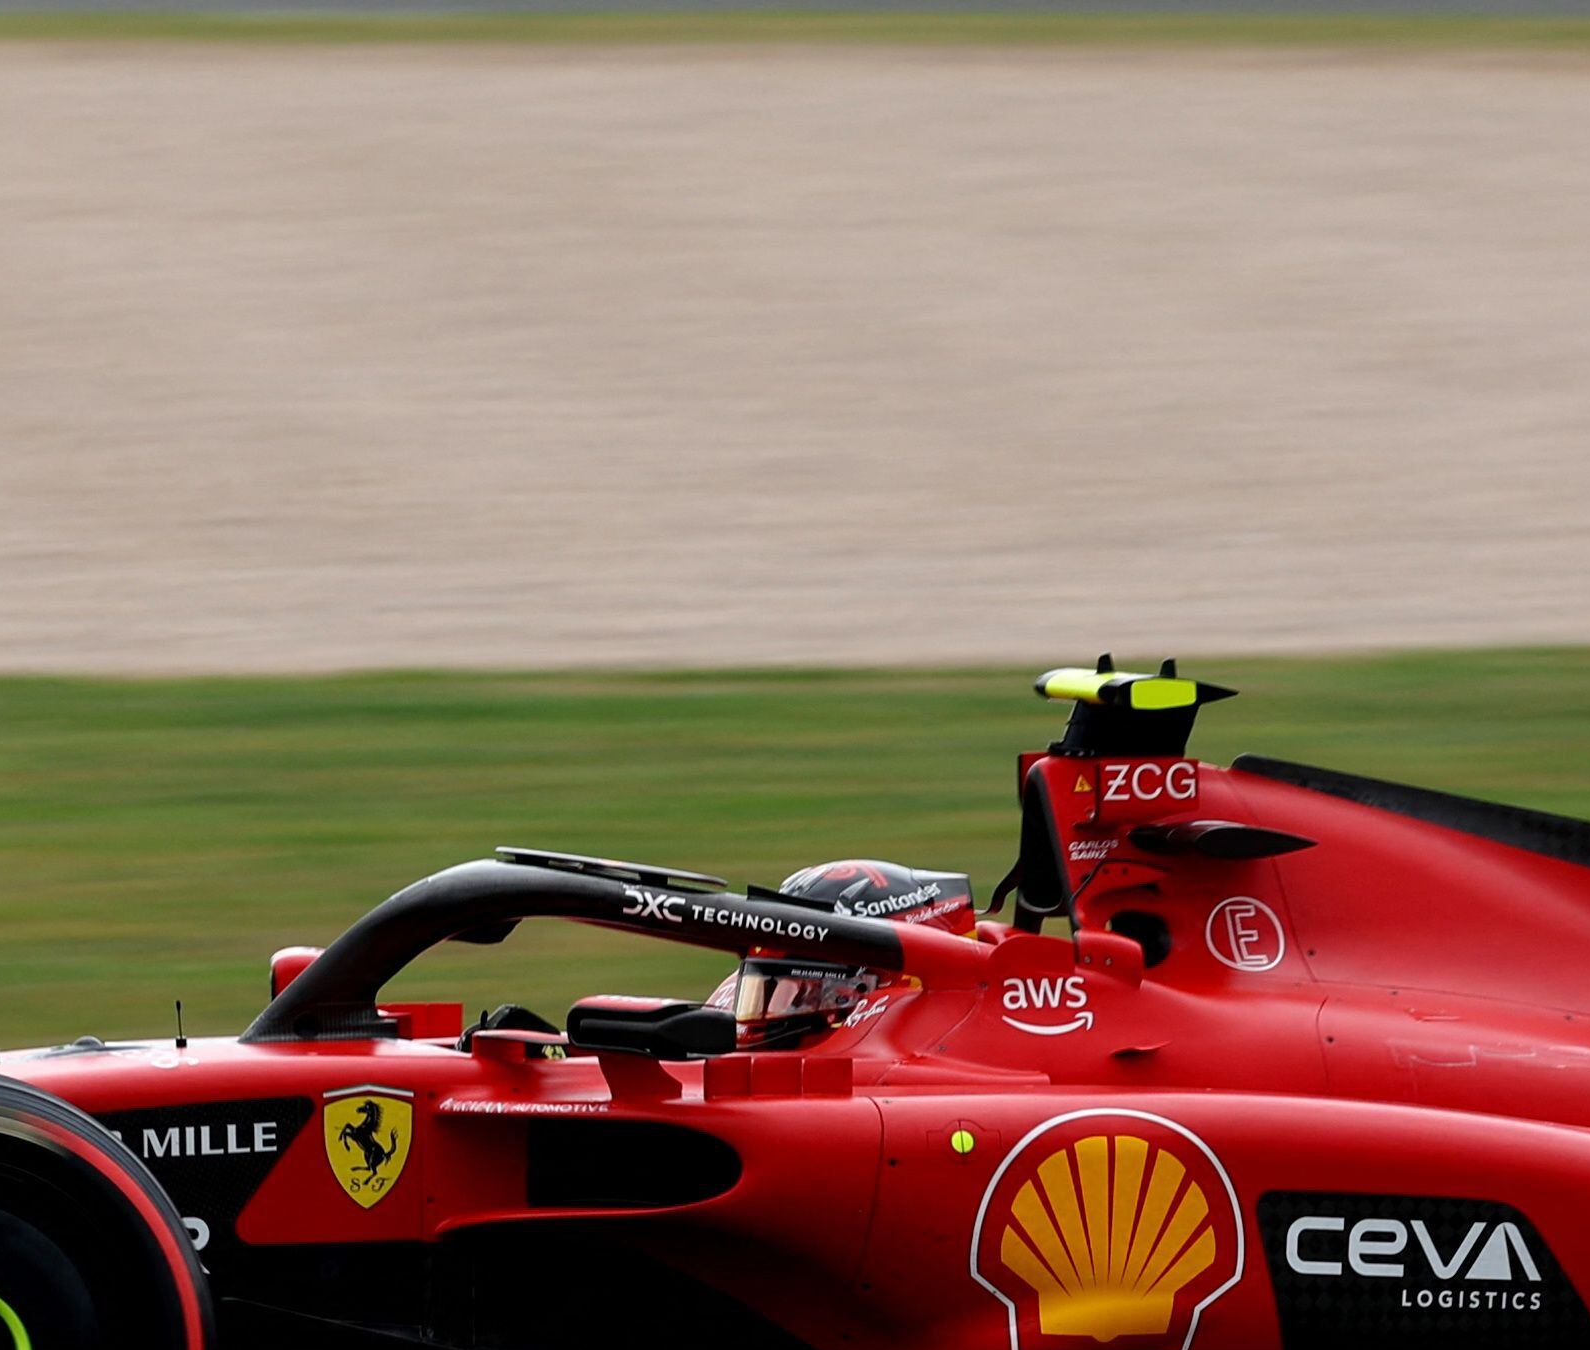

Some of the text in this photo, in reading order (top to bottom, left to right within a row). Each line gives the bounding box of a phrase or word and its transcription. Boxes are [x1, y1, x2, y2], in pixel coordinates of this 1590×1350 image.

[622, 890, 829, 943] DXC TECHNOLOGY
[854, 882, 942, 917] Santander
[1003, 975, 1087, 1010] aws
[142, 1121, 279, 1160] MILLE
[1400, 1288, 1543, 1312] LOGISTICS
